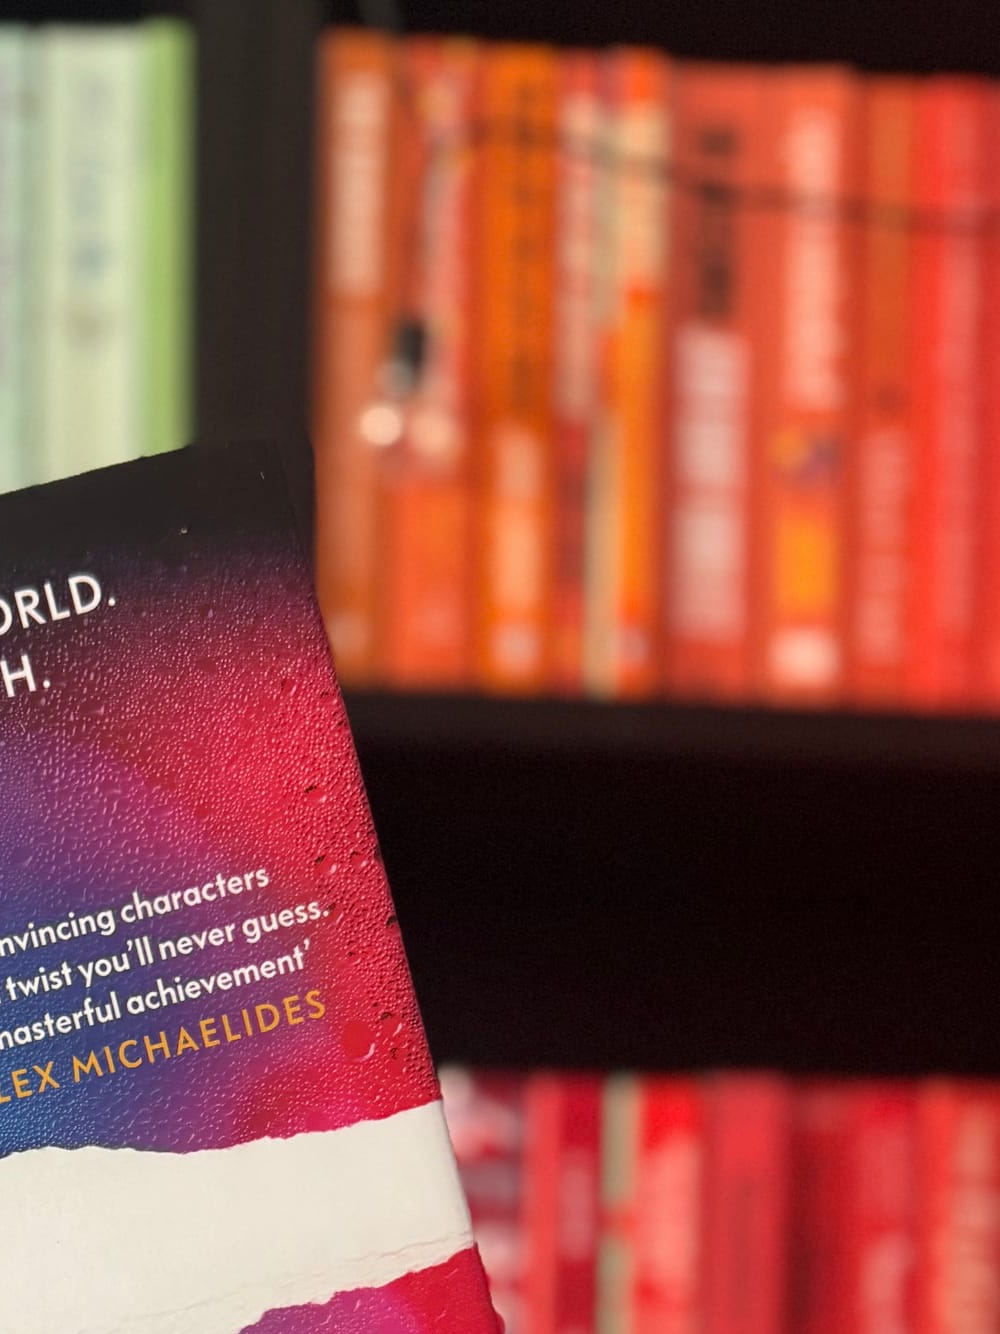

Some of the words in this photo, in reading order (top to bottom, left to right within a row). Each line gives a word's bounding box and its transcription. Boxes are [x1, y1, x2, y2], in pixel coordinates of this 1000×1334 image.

[119, 867, 270, 924] characters
[5, 961, 74, 1003] twist
[158, 922, 237, 961] never
[241, 900, 330, 944] guess.
[71, 989, 328, 1084] MICHAELIDES
